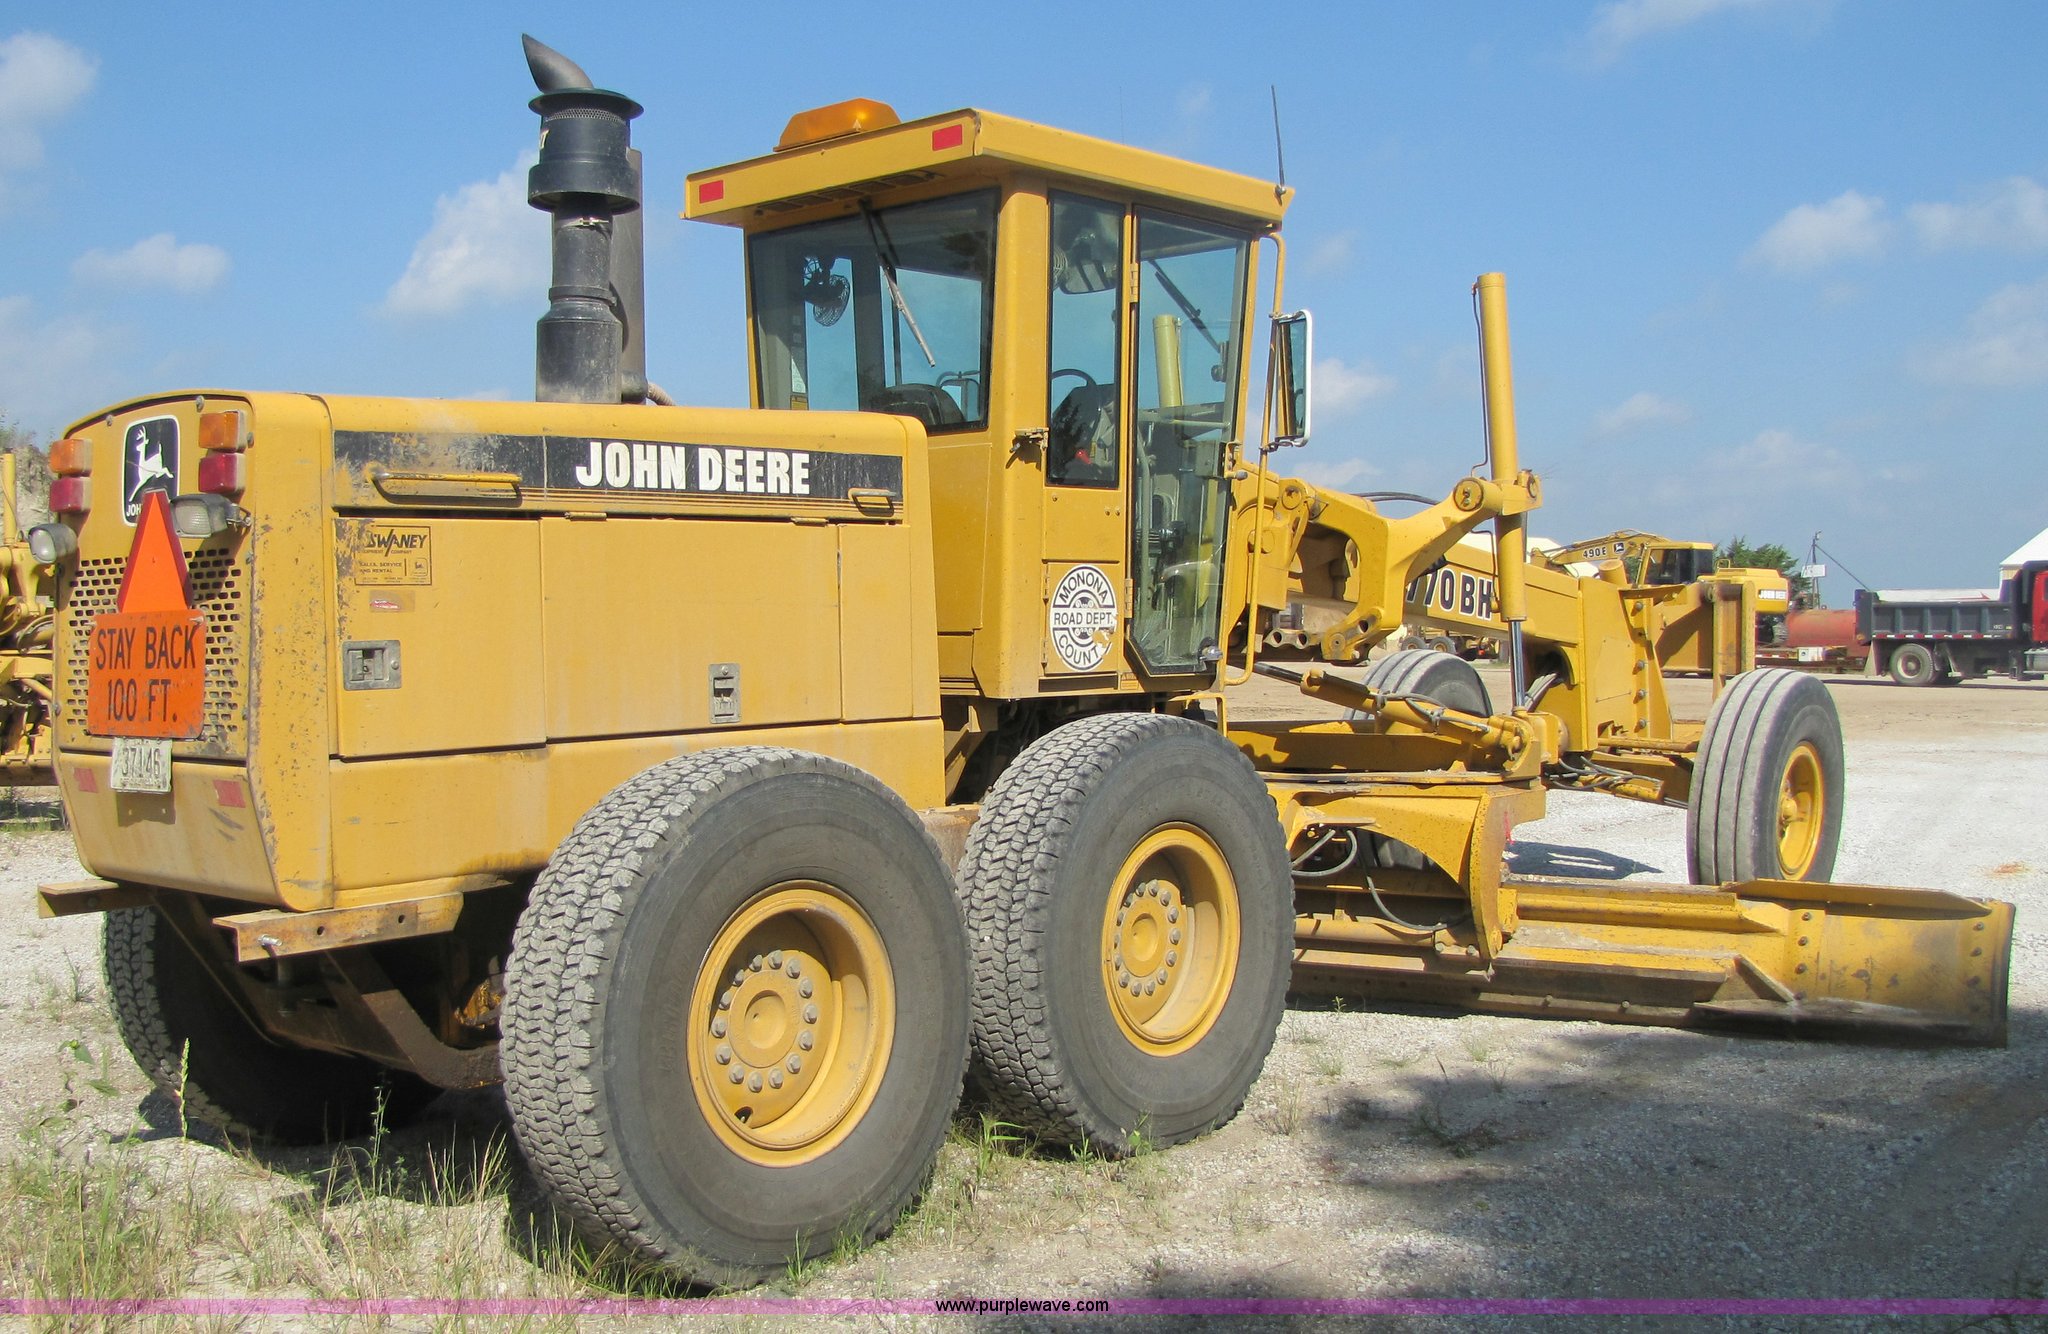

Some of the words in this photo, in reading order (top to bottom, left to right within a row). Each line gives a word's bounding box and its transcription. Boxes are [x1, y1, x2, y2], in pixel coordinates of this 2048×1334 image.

[575, 441, 687, 490] JOHN
[697, 446, 811, 495] DEERE
[126, 503, 142, 517] JOH
[1583, 546, 1607, 559] 490E
[1058, 571, 1108, 604] MONONA
[1053, 612, 1084, 626] ROAD
[1086, 612, 1114, 625] DEPT.
[95, 626, 137, 670] STAY
[145, 622, 201, 670] BACK
[1059, 634, 1100, 666] COUNT
[107, 678, 138, 722] 100
[147, 678, 178, 723] FT.
